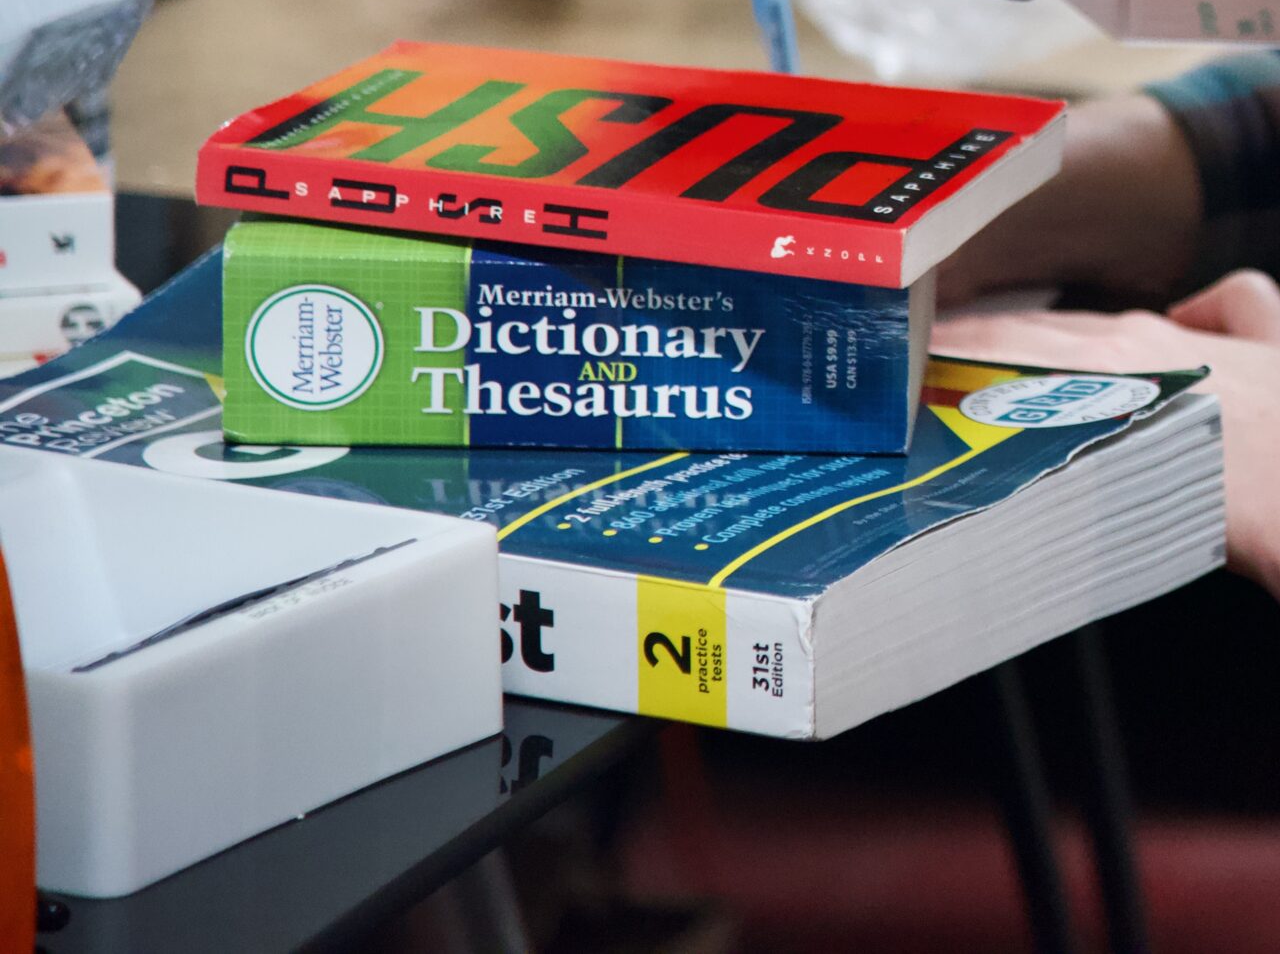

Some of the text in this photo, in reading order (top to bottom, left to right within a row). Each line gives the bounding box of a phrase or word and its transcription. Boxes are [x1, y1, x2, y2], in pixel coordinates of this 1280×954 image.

[240, 68, 1014, 223] PUSH
[873, 132, 997, 214] SAPPHIRE
[225, 165, 609, 240] PUSH
[294, 181, 537, 224] SAPPHIRE
[806, 247, 884, 264] KNOPF
[476, 284, 734, 312] Merriam-Webster's
[292, 296, 315, 394] Merriam-
[318, 304, 343, 392] Webster
[413, 306, 766, 373] Dictionary
[826, 329, 839, 389] USA $9.99
[846, 329, 857, 389] CAN $13.99
[411, 364, 753, 420] Thesaurus
[578, 361, 638, 383] AND
[5, 383, 186, 446] Princeton
[1002, 380, 1110, 423] GED
[459, 466, 587, 522] 31st Edition
[564, 513, 592, 524] 2
[576, 478, 673, 516] full-length
[610, 510, 655, 531] 860
[654, 506, 723, 538] Proven
[702, 468, 892, 544] Complete content review
[644, 631, 692, 676] 2
[696, 628, 710, 694] practice
[711, 643, 723, 682] tests
[752, 642, 770, 692] 31st
[772, 642, 783, 698] Edition
